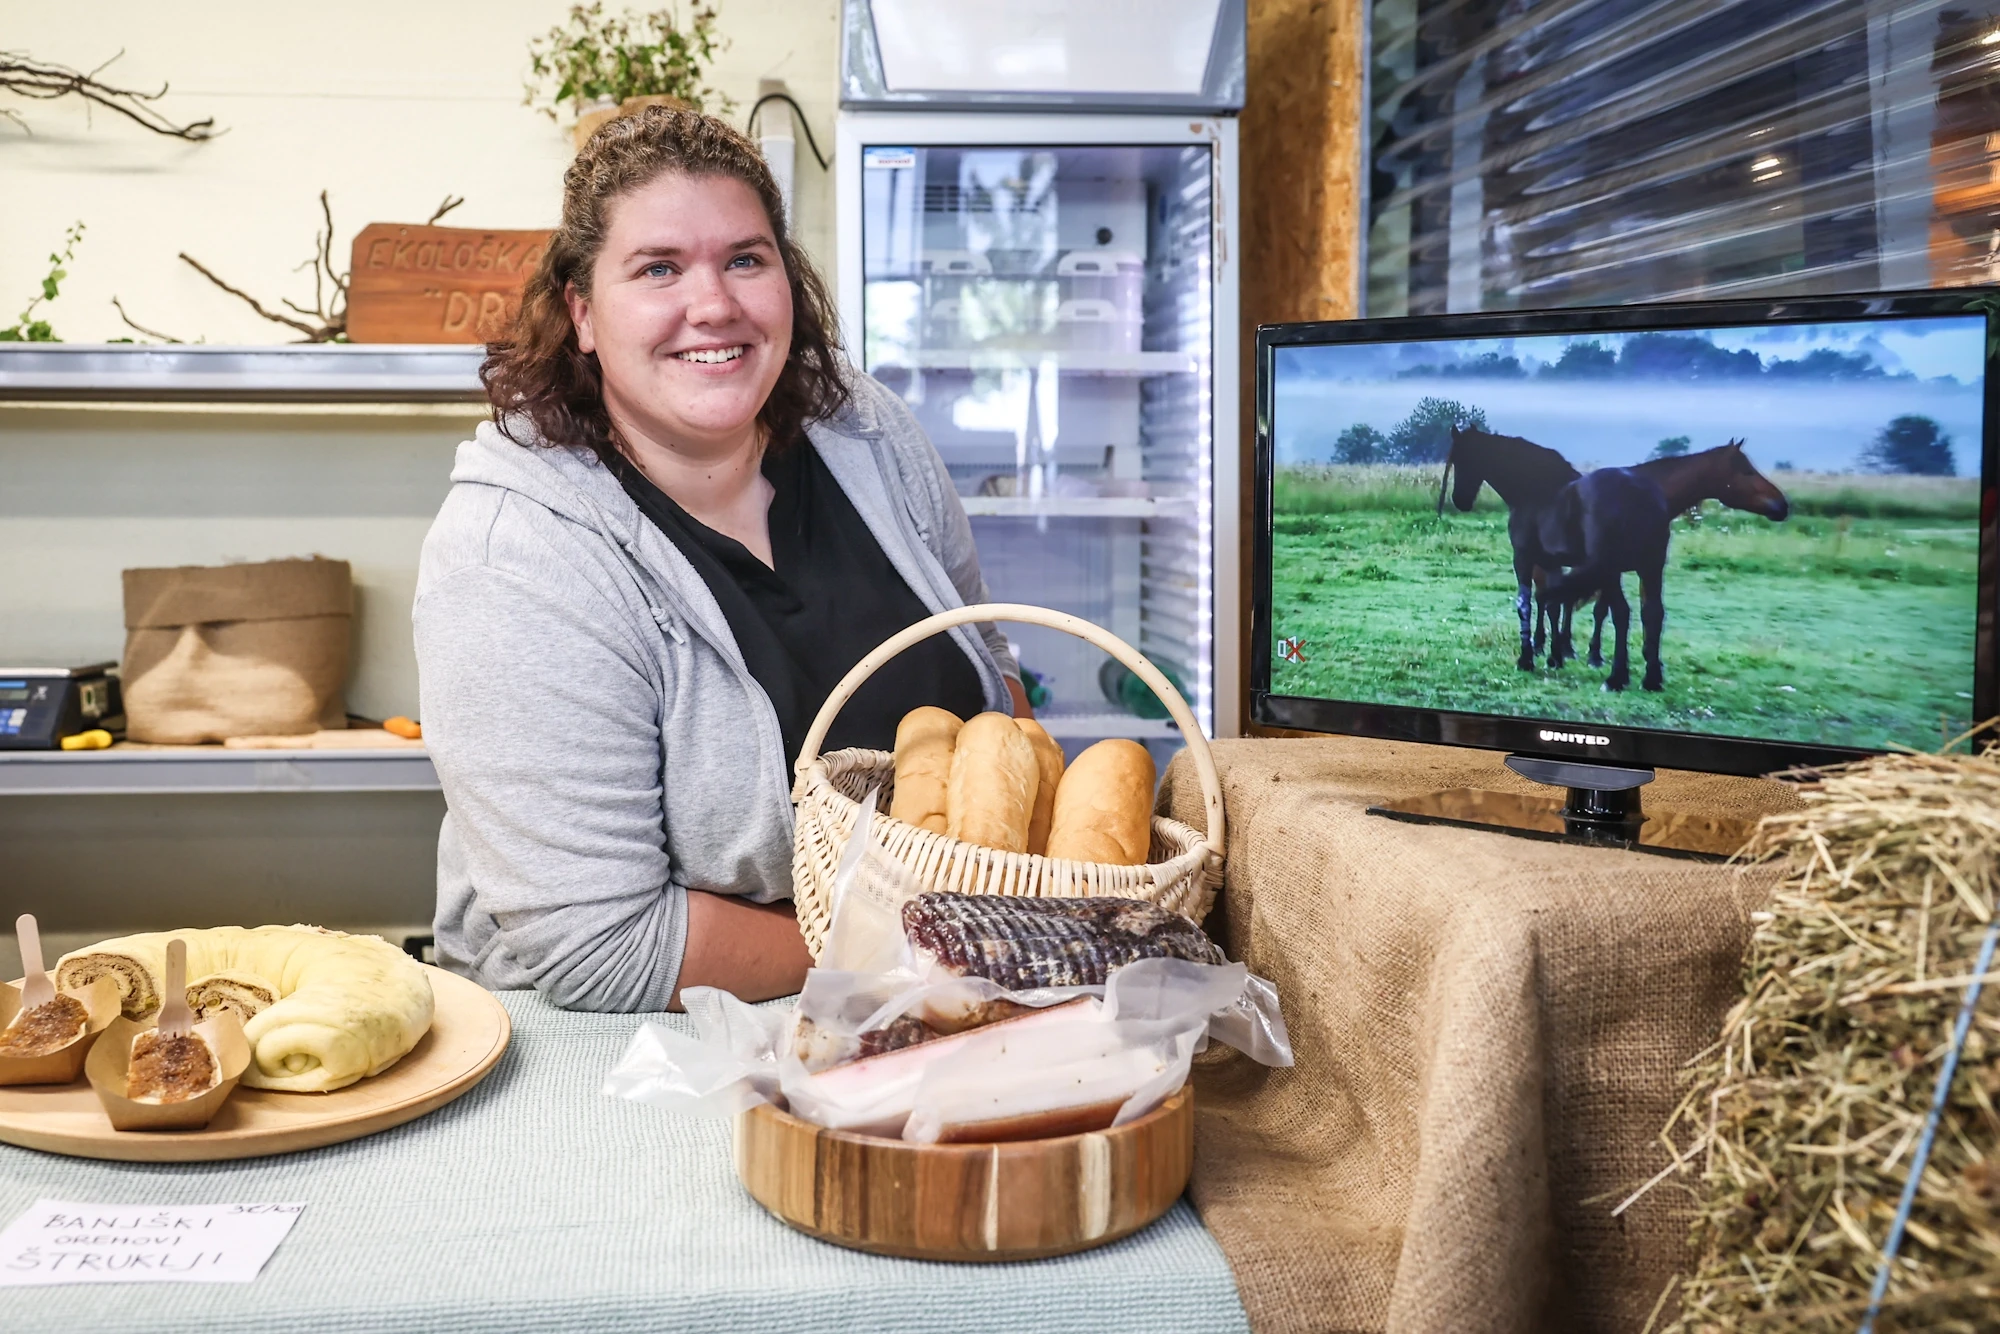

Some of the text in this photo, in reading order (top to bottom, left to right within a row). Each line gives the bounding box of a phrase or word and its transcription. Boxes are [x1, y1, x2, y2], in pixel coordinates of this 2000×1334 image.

[367, 235, 541, 273] EKOLOŠKA
[1540, 730, 1610, 746] UNITED
[53, 1235, 181, 1246] OREHOVI
[6, 1247, 224, 1271] ŠTRUKLJI
